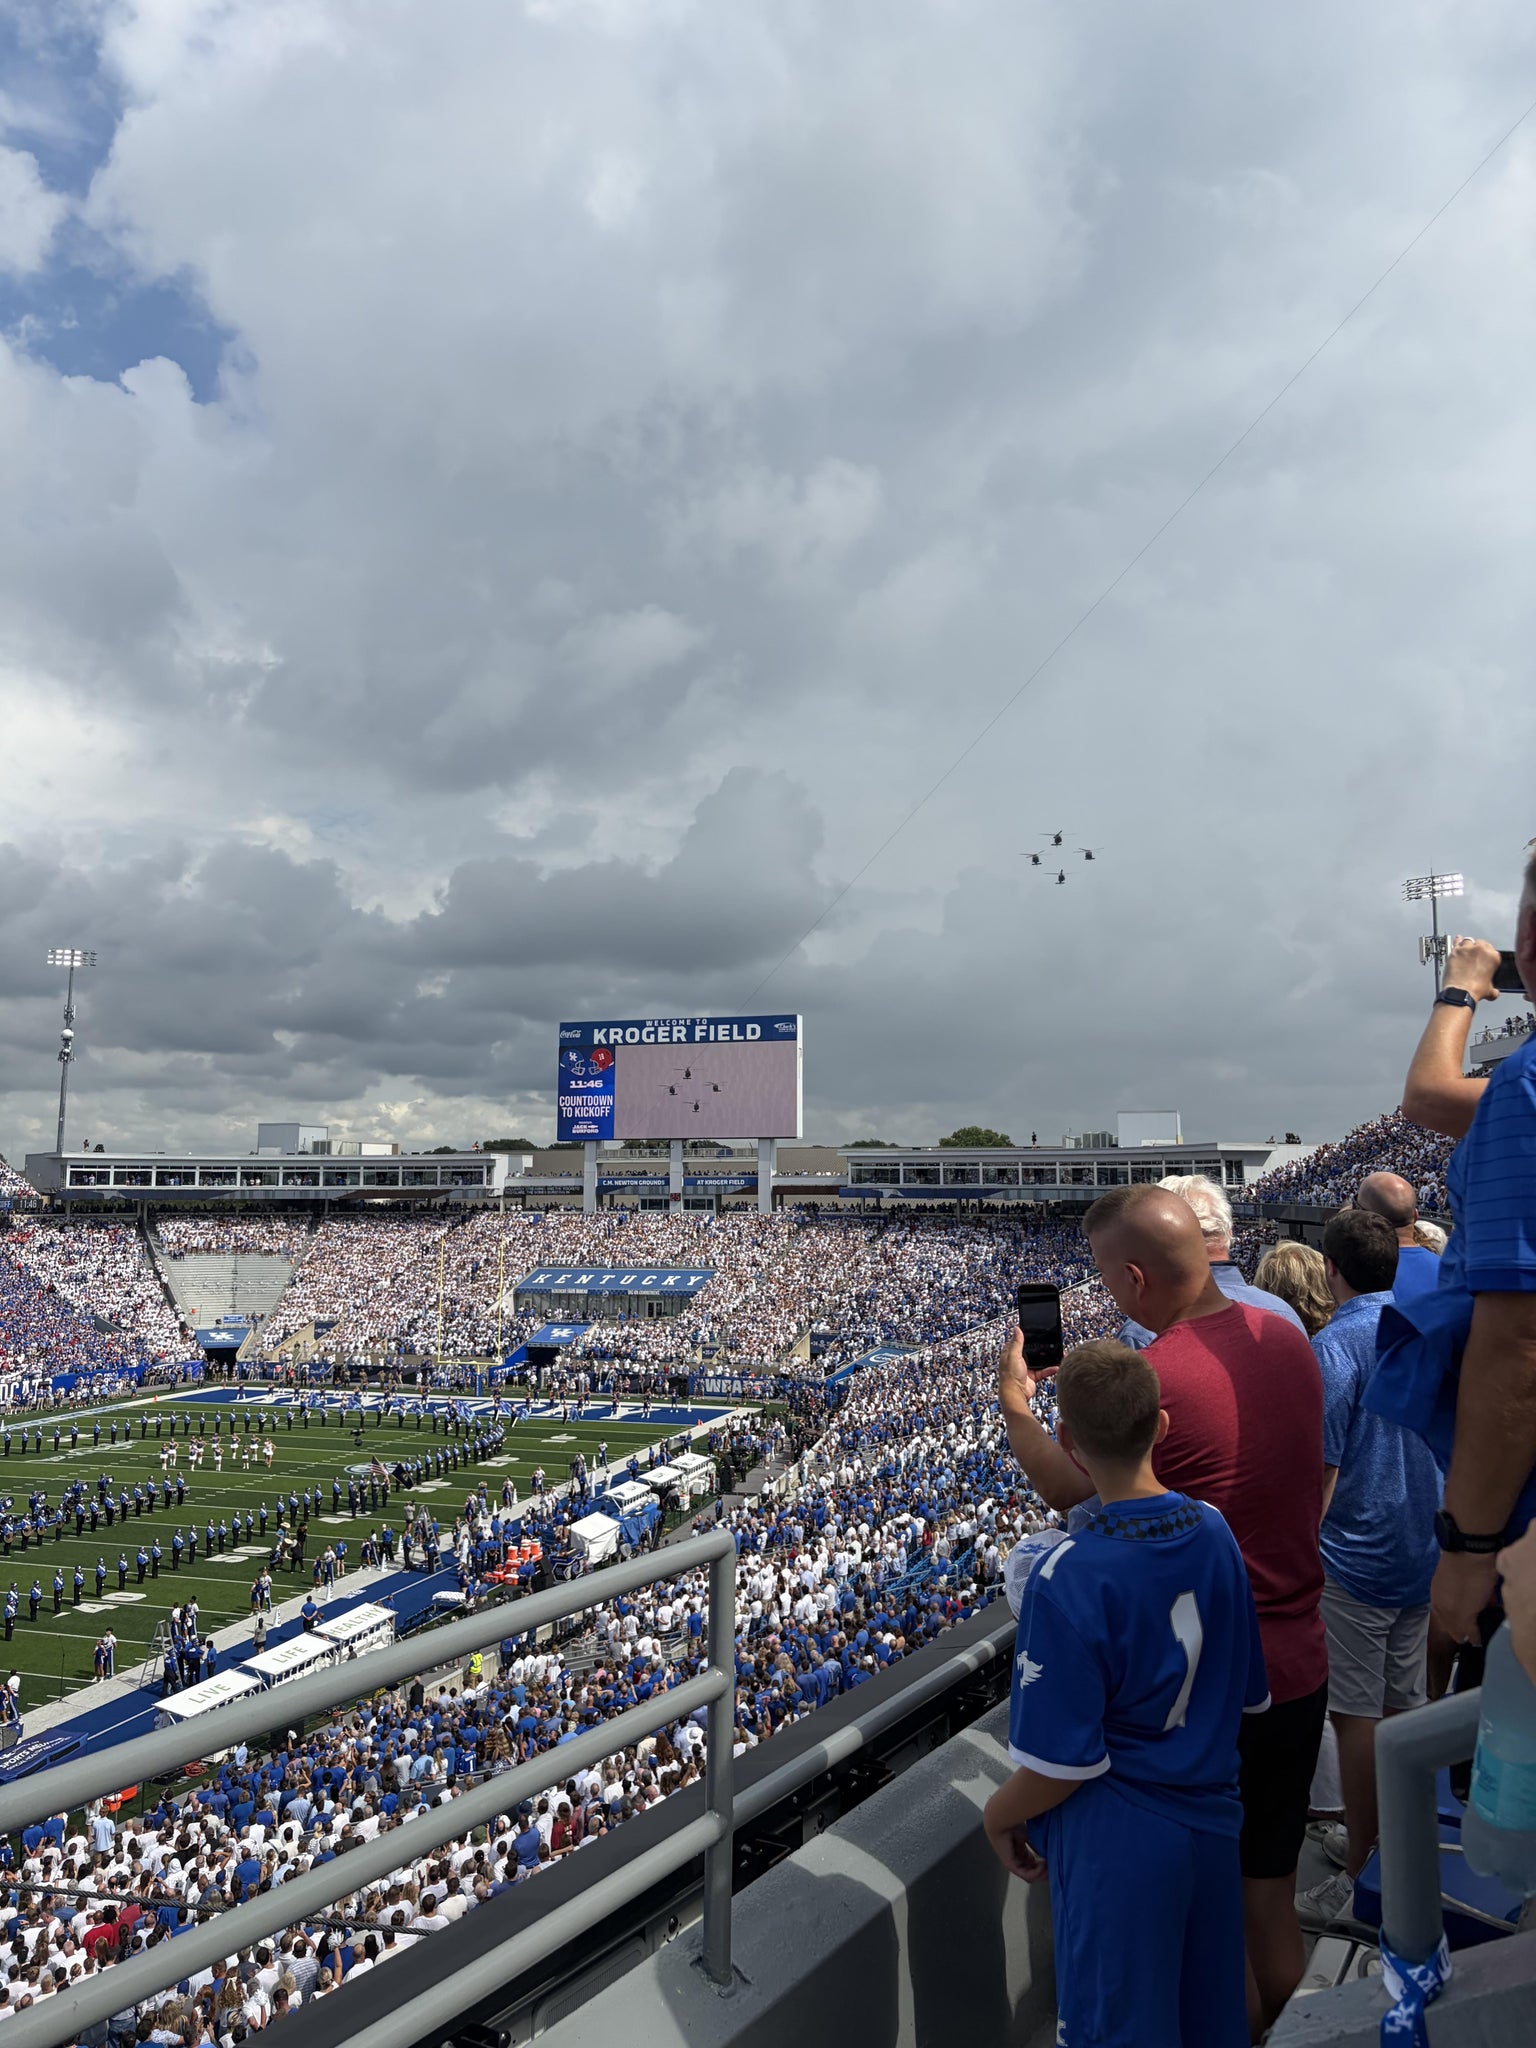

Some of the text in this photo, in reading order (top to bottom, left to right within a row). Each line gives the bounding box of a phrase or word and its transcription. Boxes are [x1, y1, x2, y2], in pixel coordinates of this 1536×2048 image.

[645, 1018, 691, 1027] WELCOME
[593, 1023, 761, 1045] KROGER FIELD
[559, 1095, 613, 1107] COUNTDOWN
[562, 1106, 611, 1118] TO KICKOFF
[532, 1273, 703, 1286] KENTUCKY
[325, 1607, 385, 1636] HEALTHY
[272, 1645, 308, 1664] LIFE
[1161, 1589, 1204, 1732] 1
[188, 1683, 231, 1704] LIVE
